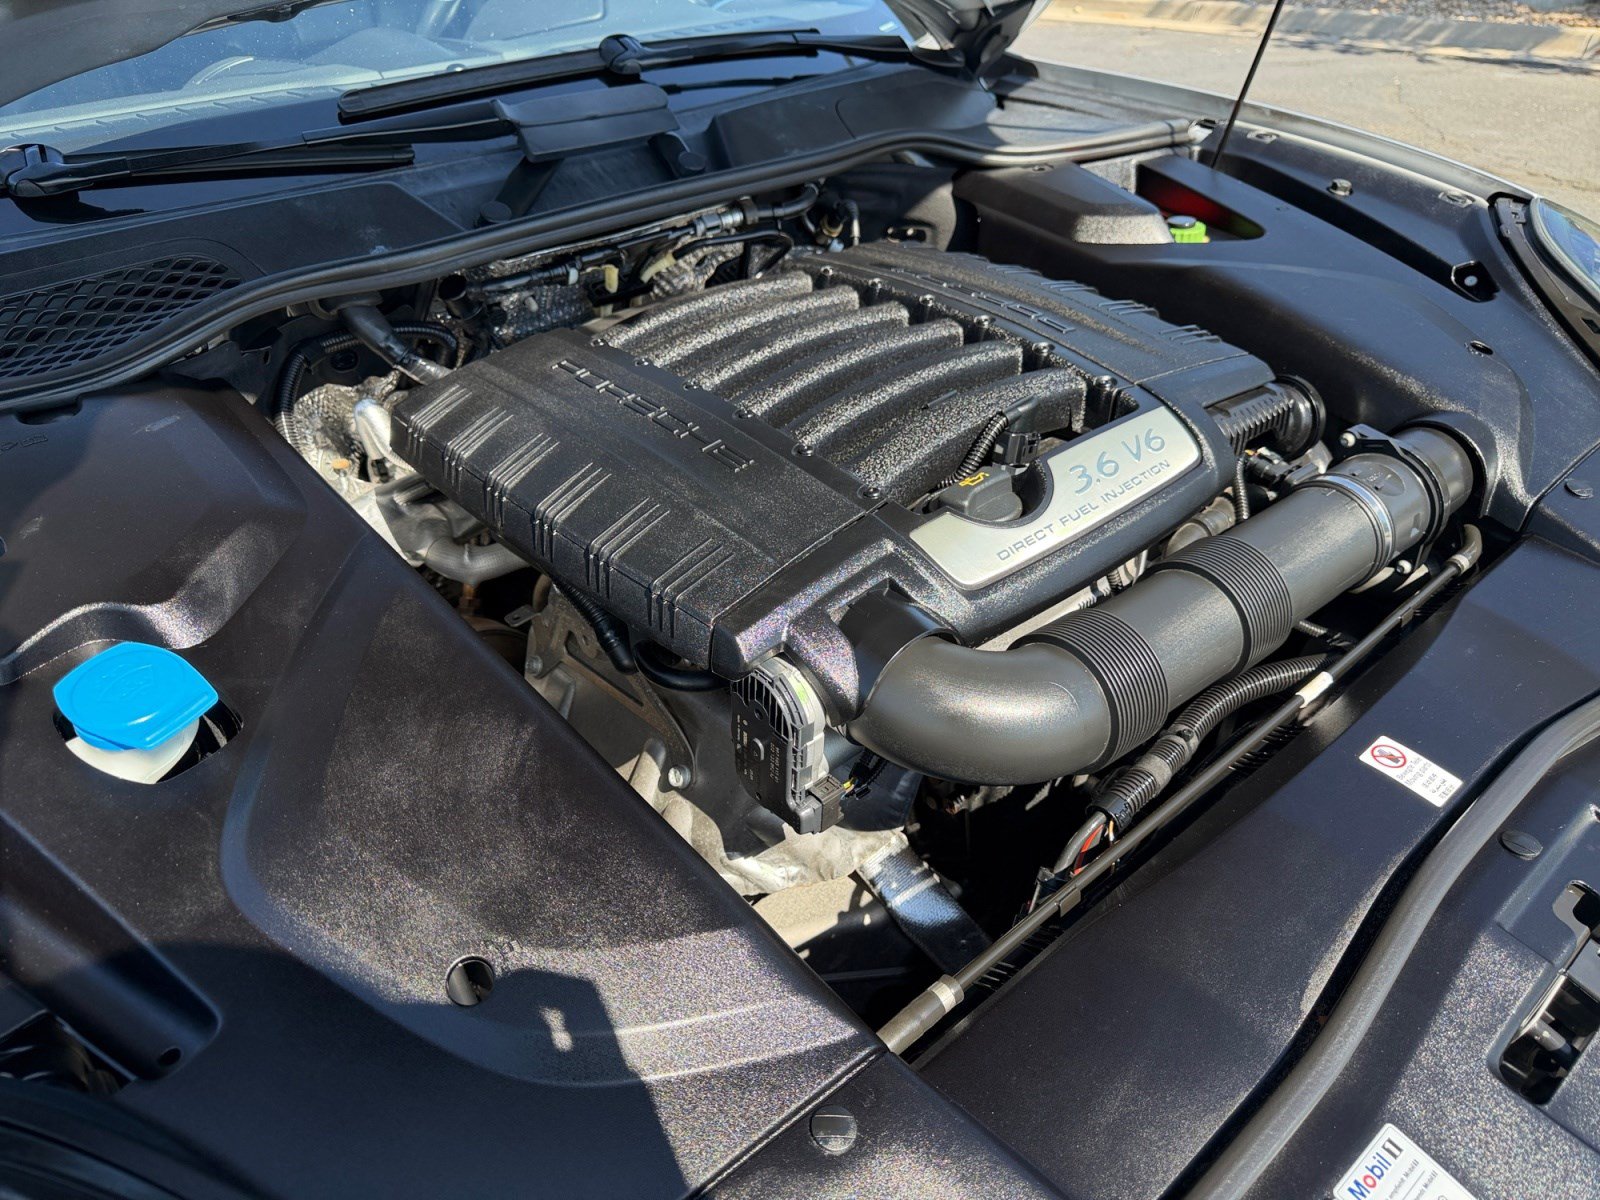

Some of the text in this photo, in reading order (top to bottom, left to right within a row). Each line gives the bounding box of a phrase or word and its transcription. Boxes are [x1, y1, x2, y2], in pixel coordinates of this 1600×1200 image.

[551, 360, 755, 474] PORSCHE
[1069, 428, 1166, 495] 3.6 V6
[997, 459, 1171, 561] DIRECT FUEL INJECTION
[1347, 1137, 1404, 1200] Mobil 1
